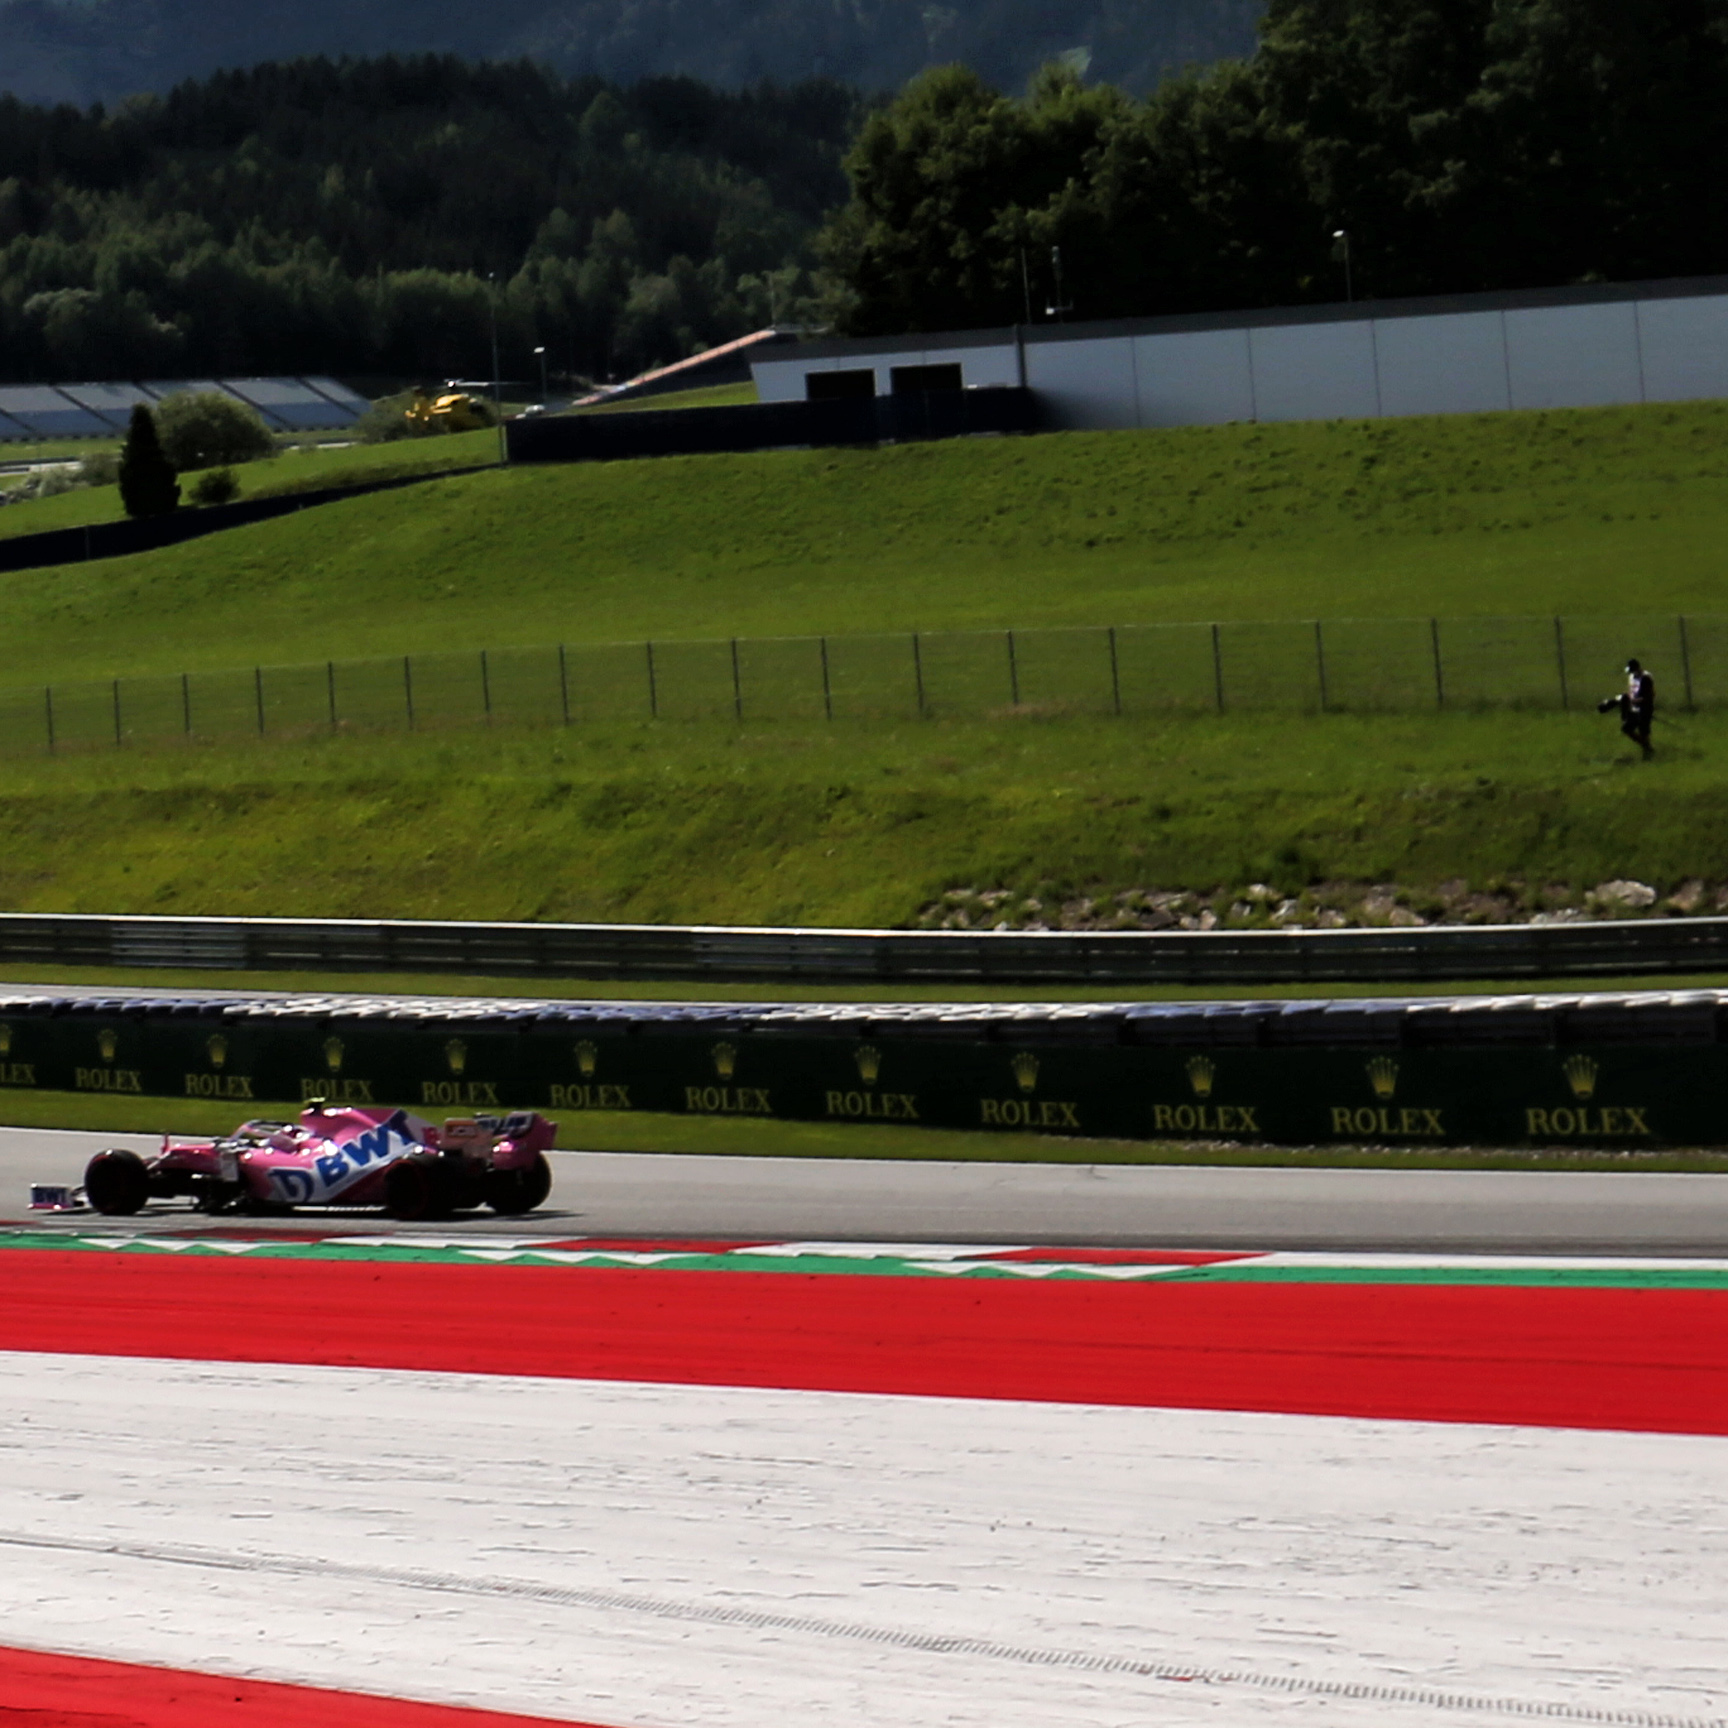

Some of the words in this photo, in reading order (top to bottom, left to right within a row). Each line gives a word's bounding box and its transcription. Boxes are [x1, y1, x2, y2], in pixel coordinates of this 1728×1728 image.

[76, 1068, 142, 1093] ROLEX
[186, 1074, 254, 1100] ROLEX
[301, 1078, 372, 1102] ROLEX
[421, 1081, 499, 1106] ROLEX
[550, 1084, 631, 1109] ROLEX
[685, 1087, 771, 1113] ROLEX
[826, 1091, 918, 1119] ROLEX
[981, 1099, 1079, 1128] ROLEX
[1153, 1105, 1258, 1133] ROLEX
[1331, 1108, 1443, 1135] ROLEX
[1526, 1107, 1650, 1136] ROLEX
[315, 1109, 416, 1188] BWT
